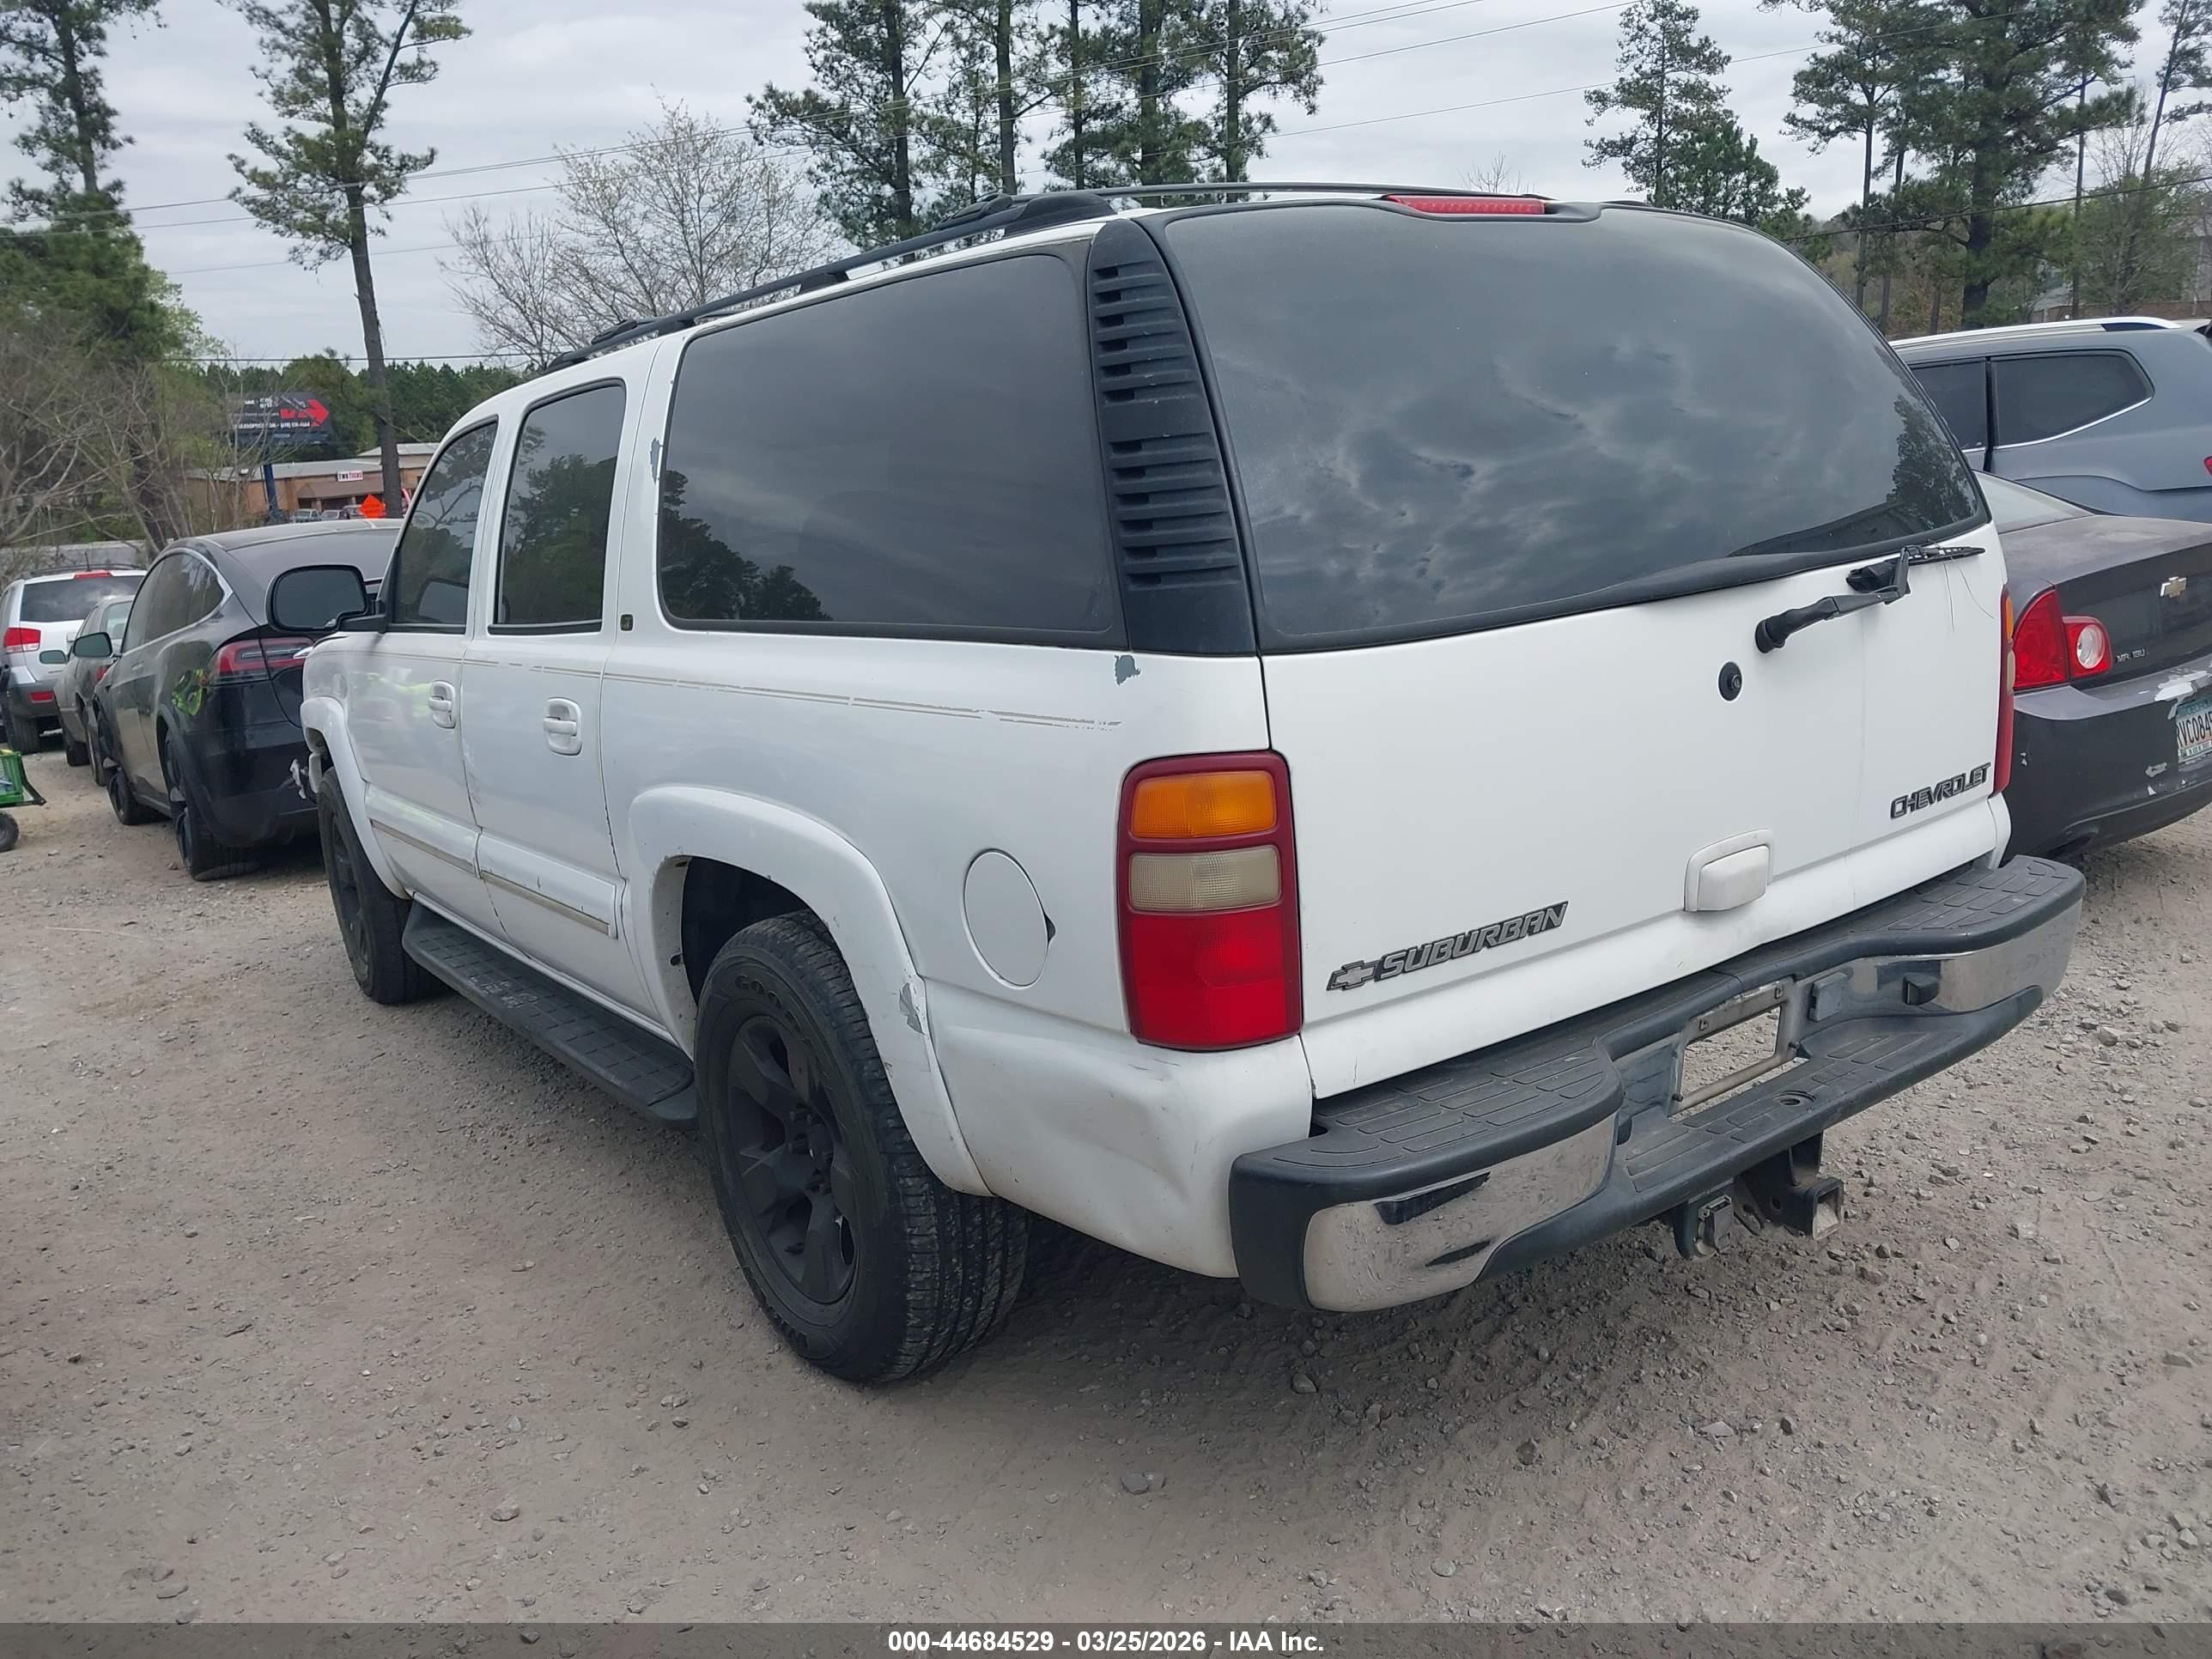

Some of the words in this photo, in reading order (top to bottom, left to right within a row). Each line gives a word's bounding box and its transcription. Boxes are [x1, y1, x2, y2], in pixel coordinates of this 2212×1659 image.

[2116, 648, 2145, 662] MAIBU
[1890, 762, 1991, 819] CHEVROLET
[1375, 901, 1568, 981] SUBURBAN
